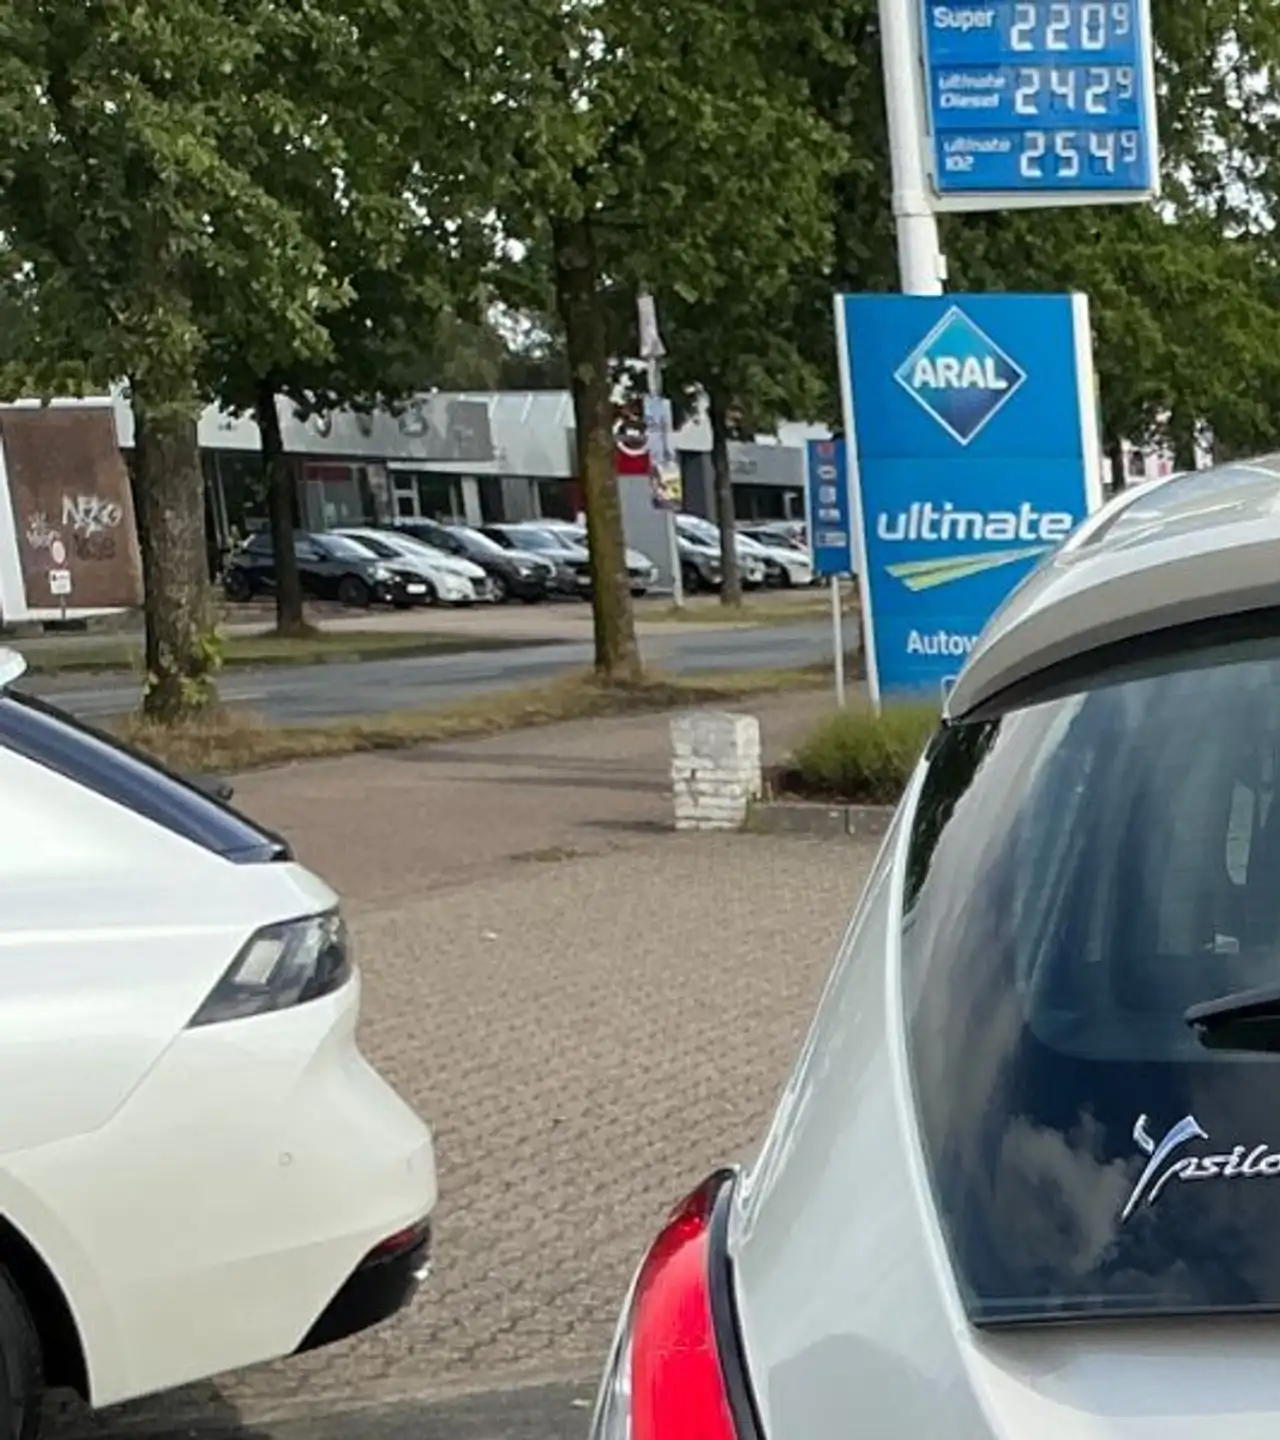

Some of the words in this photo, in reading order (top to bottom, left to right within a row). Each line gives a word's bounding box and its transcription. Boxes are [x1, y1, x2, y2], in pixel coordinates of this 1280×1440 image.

[933, 6, 996, 32] Super
[938, 72, 1006, 90] ultimate
[940, 92, 999, 109] Diesel
[943, 136, 1011, 153] ultimate
[945, 155, 975, 171] 102
[912, 355, 1009, 390] ARAL
[876, 501, 1073, 542] ultimate
